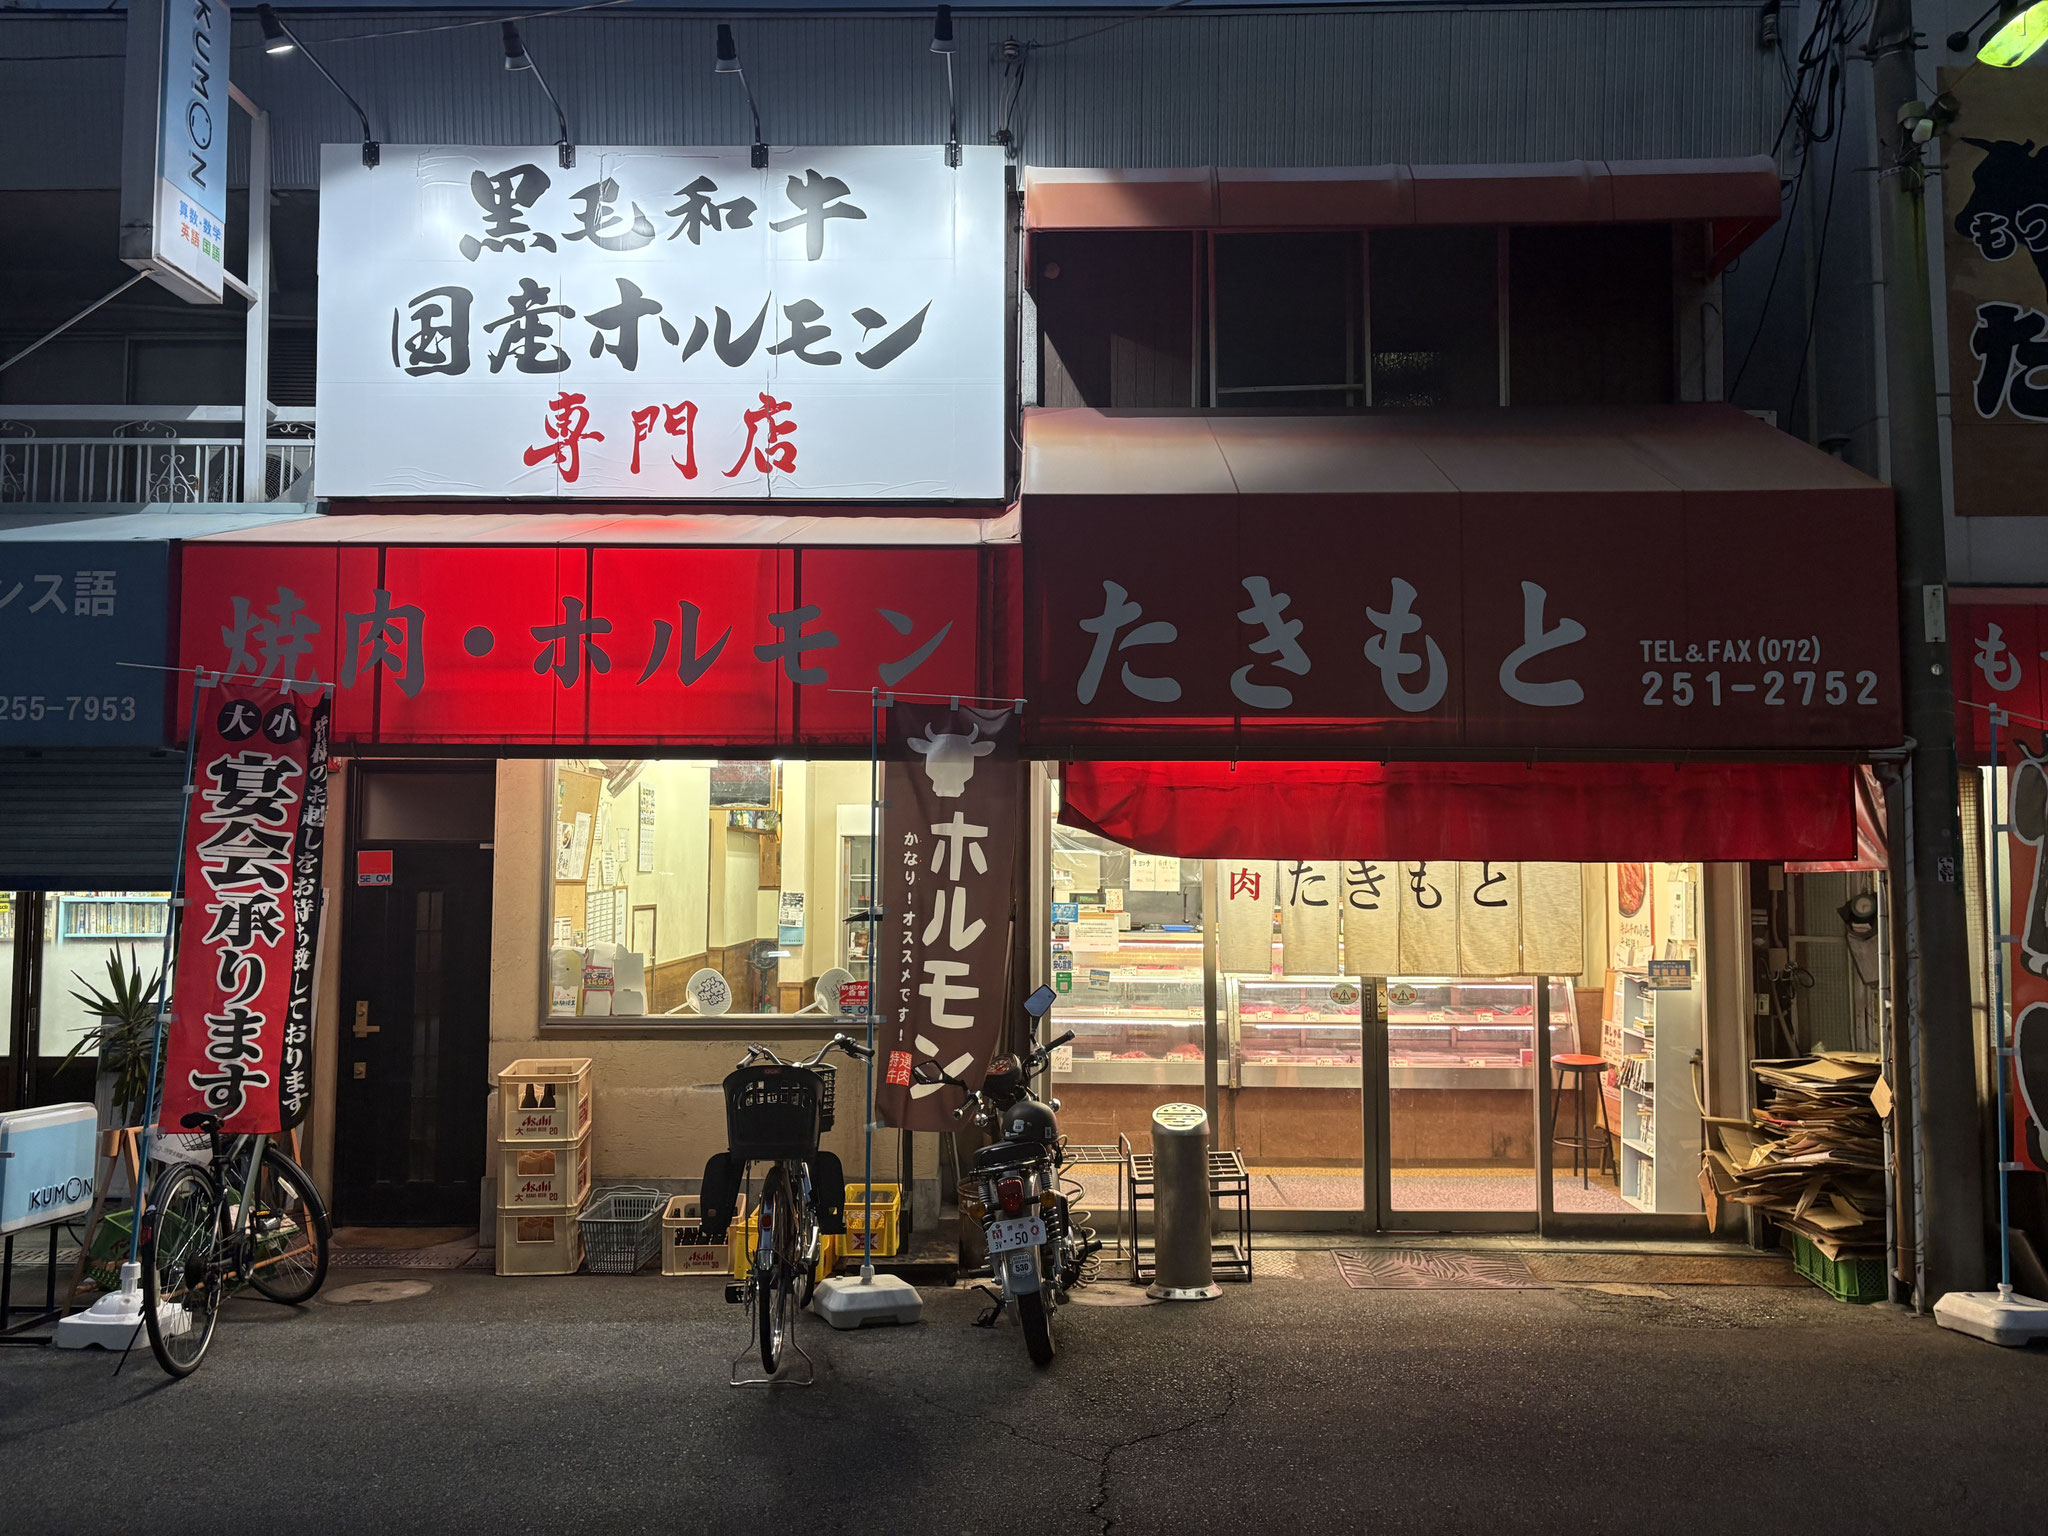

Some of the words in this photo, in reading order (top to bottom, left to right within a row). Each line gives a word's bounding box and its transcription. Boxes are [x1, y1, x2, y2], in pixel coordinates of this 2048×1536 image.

[188, 0, 212, 188] KUMON
[459, 163, 866, 262] 黒毛和牛
[391, 277, 932, 376] 国産ホルモン
[523, 392, 798, 482] 専門店
[220, 587, 953, 698] 焼肉・ホルモン
[1076, 575, 1587, 712] たきもと
[1757, 635, 1821, 665] (072)
[1641, 671, 1878, 706] 251-2752
[220, 703, 255, 736] 大
[267, 703, 297, 737] 小
[1230, 868, 1261, 900] 肉
[1288, 861, 1508, 909] たきもと
[189, 751, 303, 1119] 宴会承ります
[909, 811, 989, 1100] ホルモン
[521, 1115, 552, 1126] Asahi
[549, 1127, 558, 1135] 20
[31, 1177, 93, 1209] KUMON
[521, 1181, 552, 1192] Asahi
[549, 1193, 558, 1201] 20
[689, 1251, 713, 1261] Asahi
